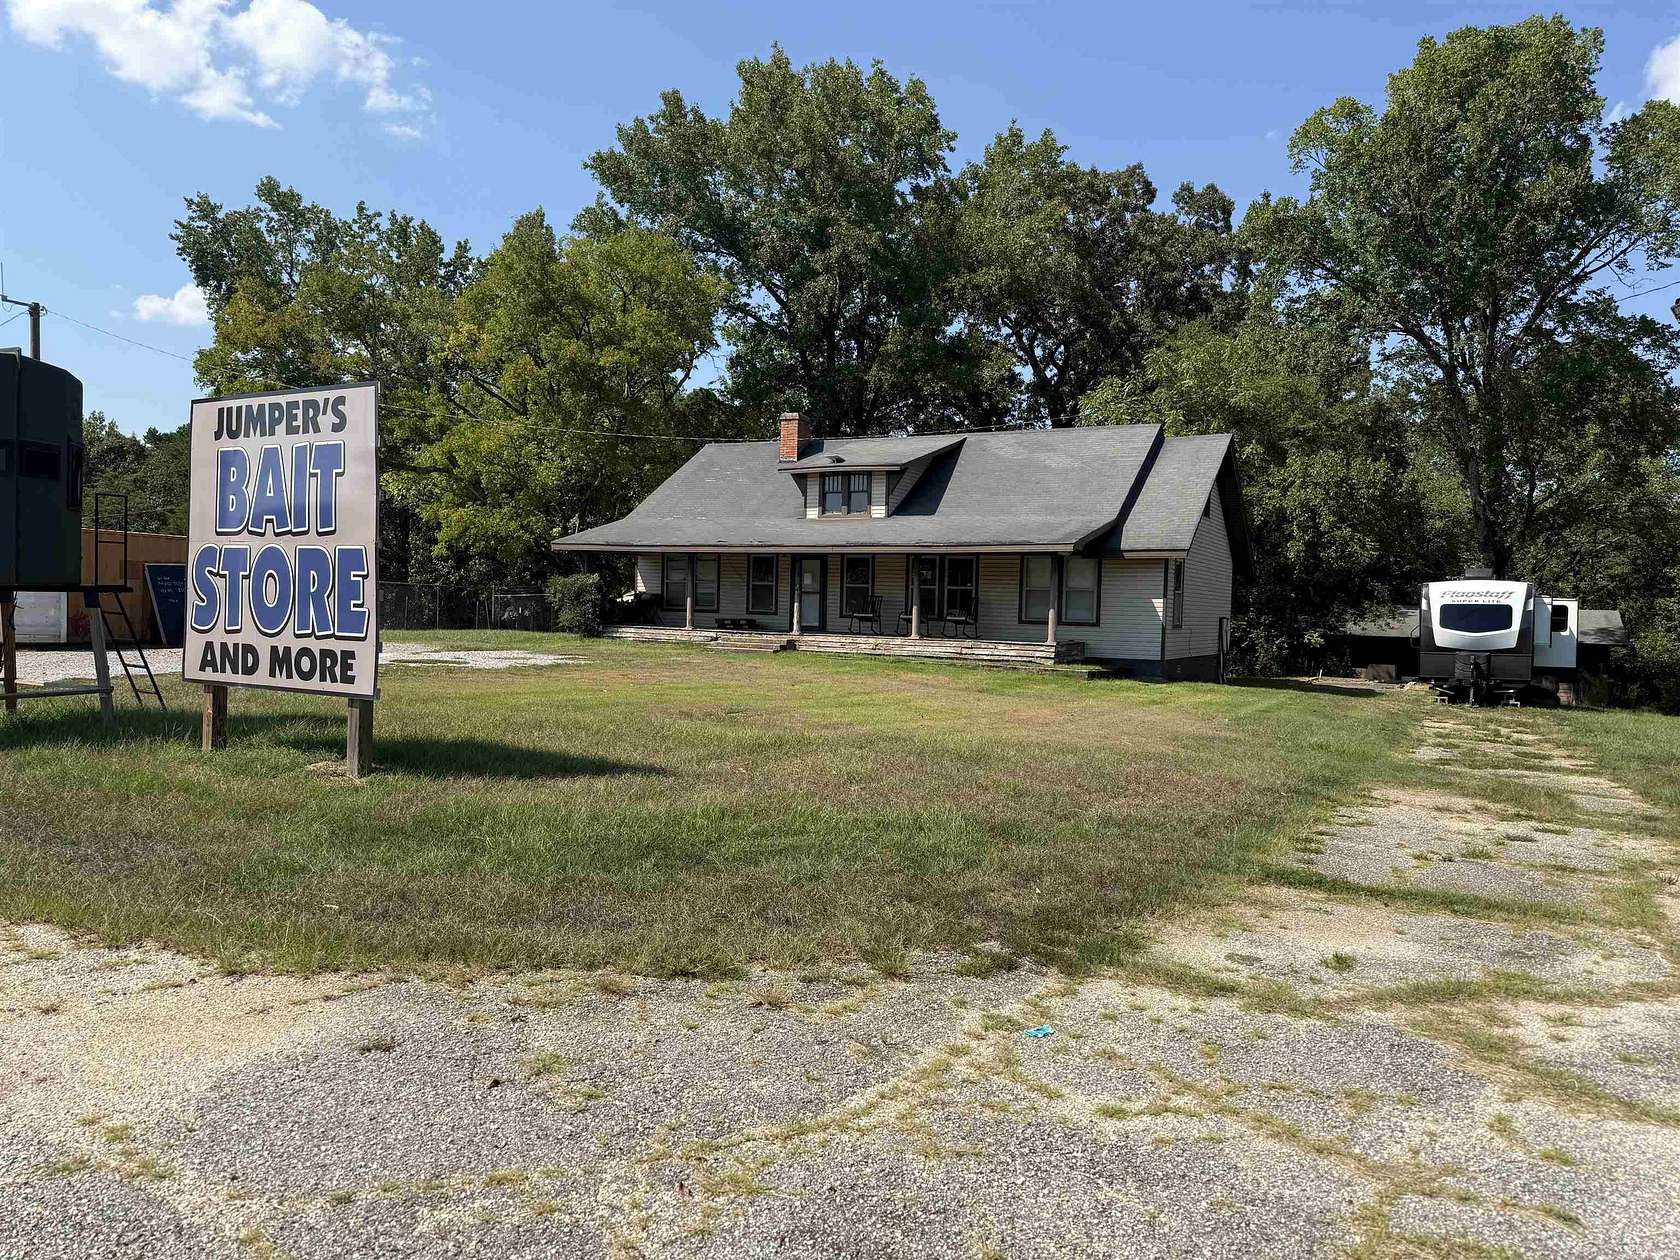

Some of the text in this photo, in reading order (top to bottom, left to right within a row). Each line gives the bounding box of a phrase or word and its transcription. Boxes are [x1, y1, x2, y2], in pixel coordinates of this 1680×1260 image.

[214, 396, 347, 441] JUMPER'S
[216, 441, 345, 536] BAIT
[191, 543, 369, 640] STORE
[1440, 591, 1516, 600] Flagstaff
[198, 641, 357, 685] AND MORE
